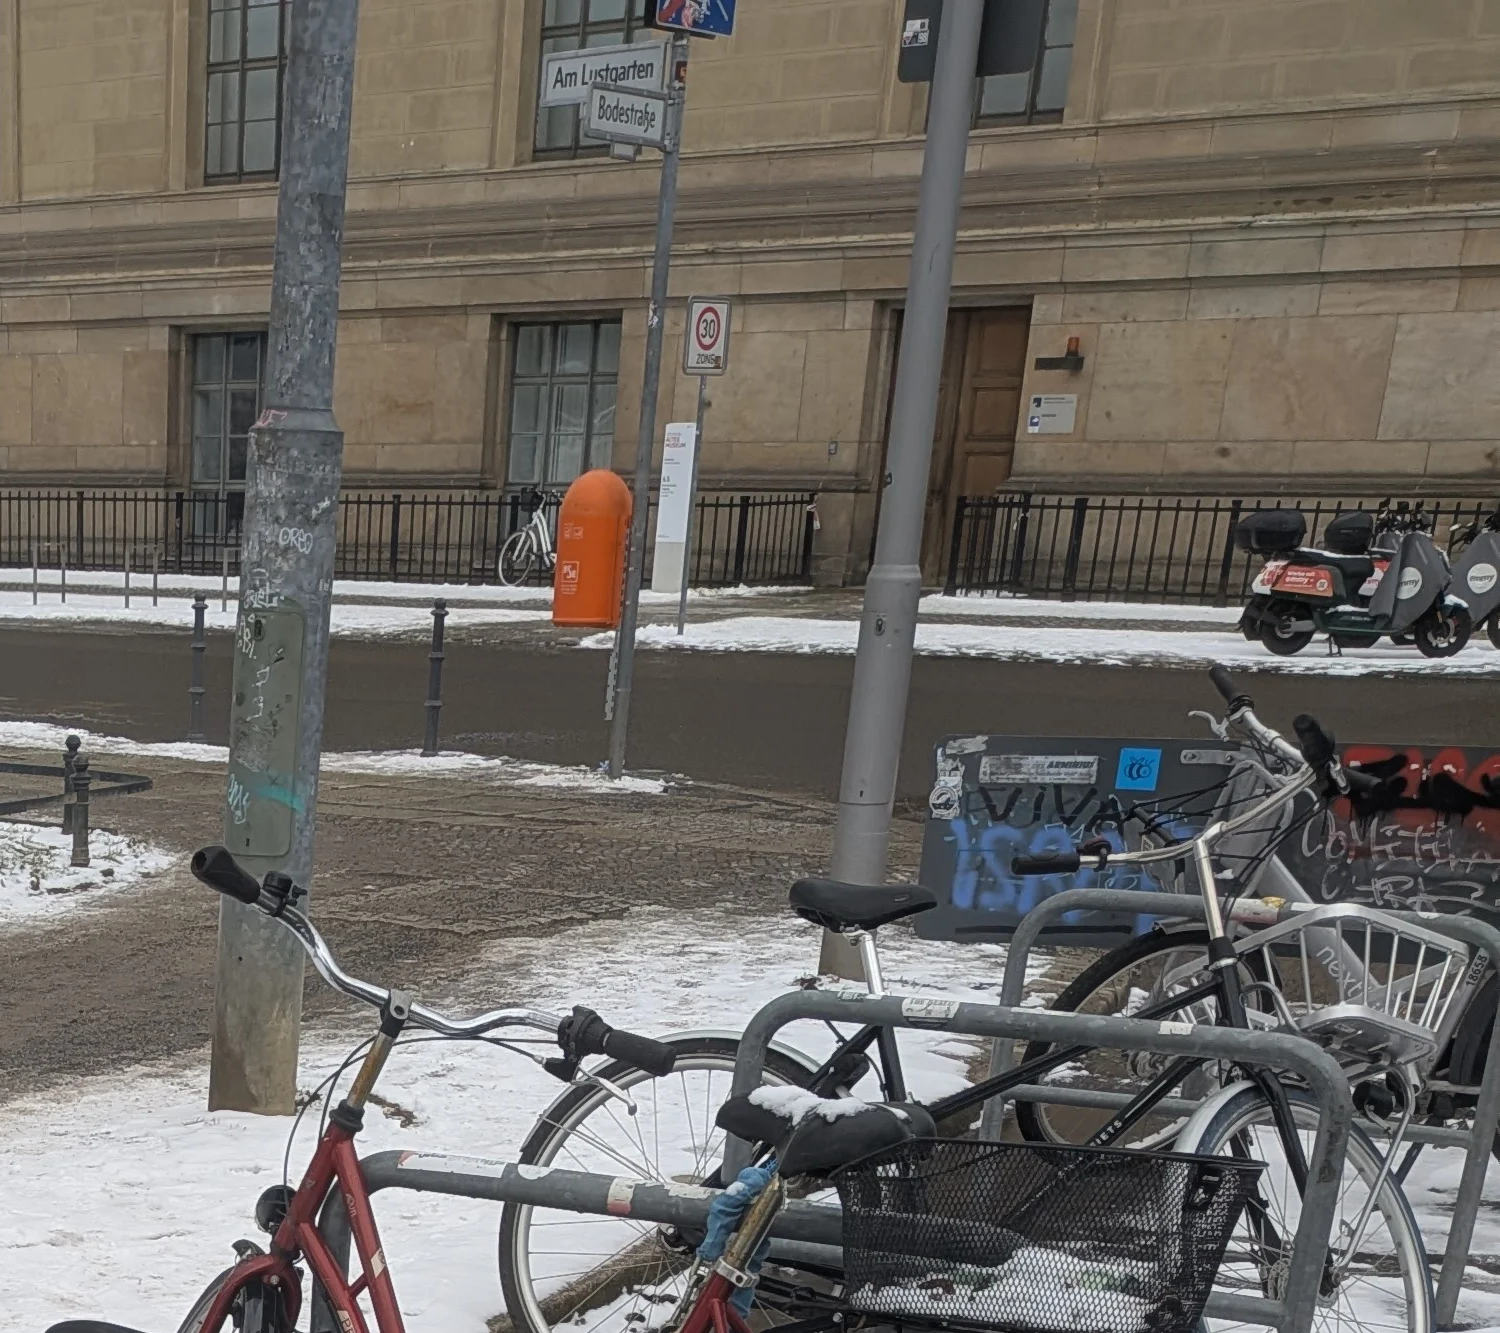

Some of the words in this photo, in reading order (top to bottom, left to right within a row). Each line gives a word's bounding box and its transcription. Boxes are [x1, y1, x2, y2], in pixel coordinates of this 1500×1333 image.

[553, 67, 577, 89] Am
[581, 60, 654, 85] Lustgarten
[598, 95, 656, 133] Bodestraße
[701, 319, 715, 338] 30
[1465, 954, 1489, 987] 18658
